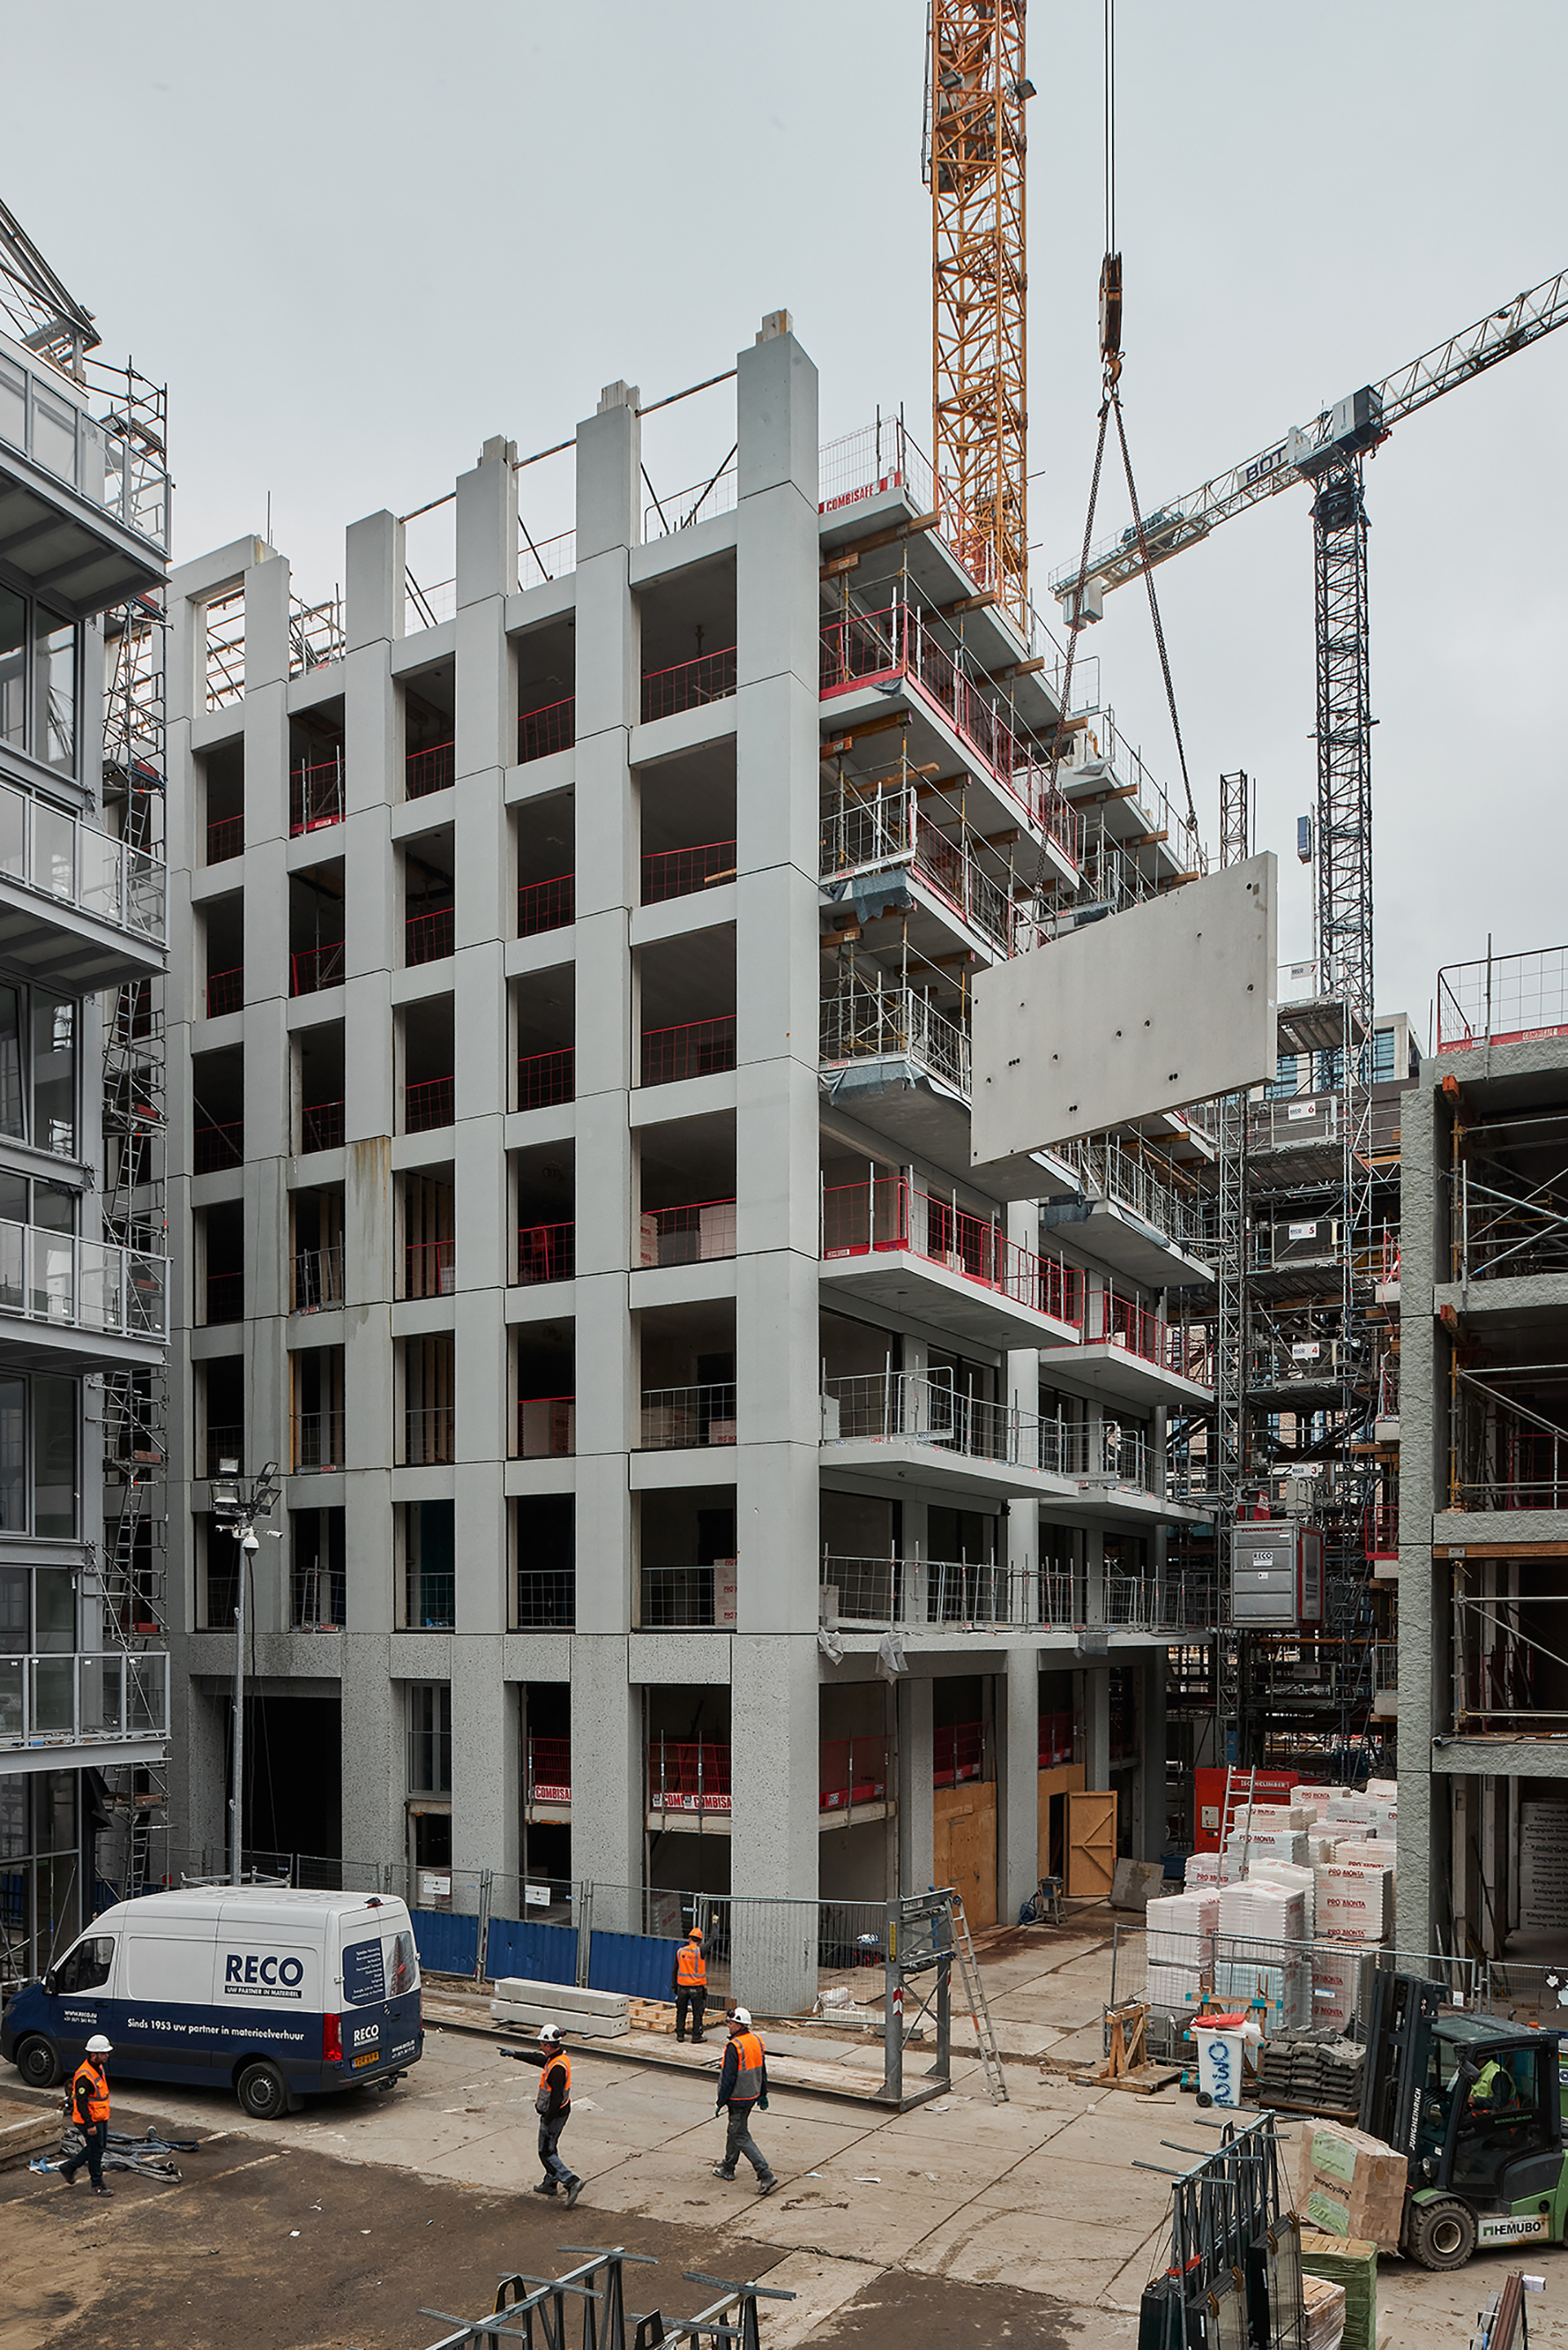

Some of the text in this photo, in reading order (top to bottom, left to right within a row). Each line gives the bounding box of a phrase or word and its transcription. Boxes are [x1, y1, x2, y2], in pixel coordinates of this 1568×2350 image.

[1247, 445, 1287, 483] BOT
[826, 484, 873, 512] COMBISAFE
[1311, 964, 1317, 973] 7
[1312, 1466, 1317, 1474] 3
[1314, 1667, 1318, 1675] 1
[1243, 1780, 1287, 1788] SCNCLIMBER
[664, 1794, 684, 1807] COM
[1253, 1835, 1275, 1844] MONTA
[1328, 1868, 1365, 1879] PRO MONTA
[1327, 1898, 1366, 1909] PRO MONTA
[1327, 1928, 1365, 1938] PRO MONTA
[225, 1954, 303, 1987] RECO
[1322, 1975, 1344, 1986] MONTA
[238, 1987, 262, 1995] PARTNER
[271, 1989, 299, 1998] MATERIEEL
[1322, 2006, 1344, 2018] MONTA
[127, 2018, 304, 2041] Sinds 1953 uw partner in materieelverhuur
[354, 2024, 379, 2042] RECO
[1409, 2087, 1422, 2151] JUNGHEINRICH
[1495, 2221, 1541, 2236] HEMUBO
